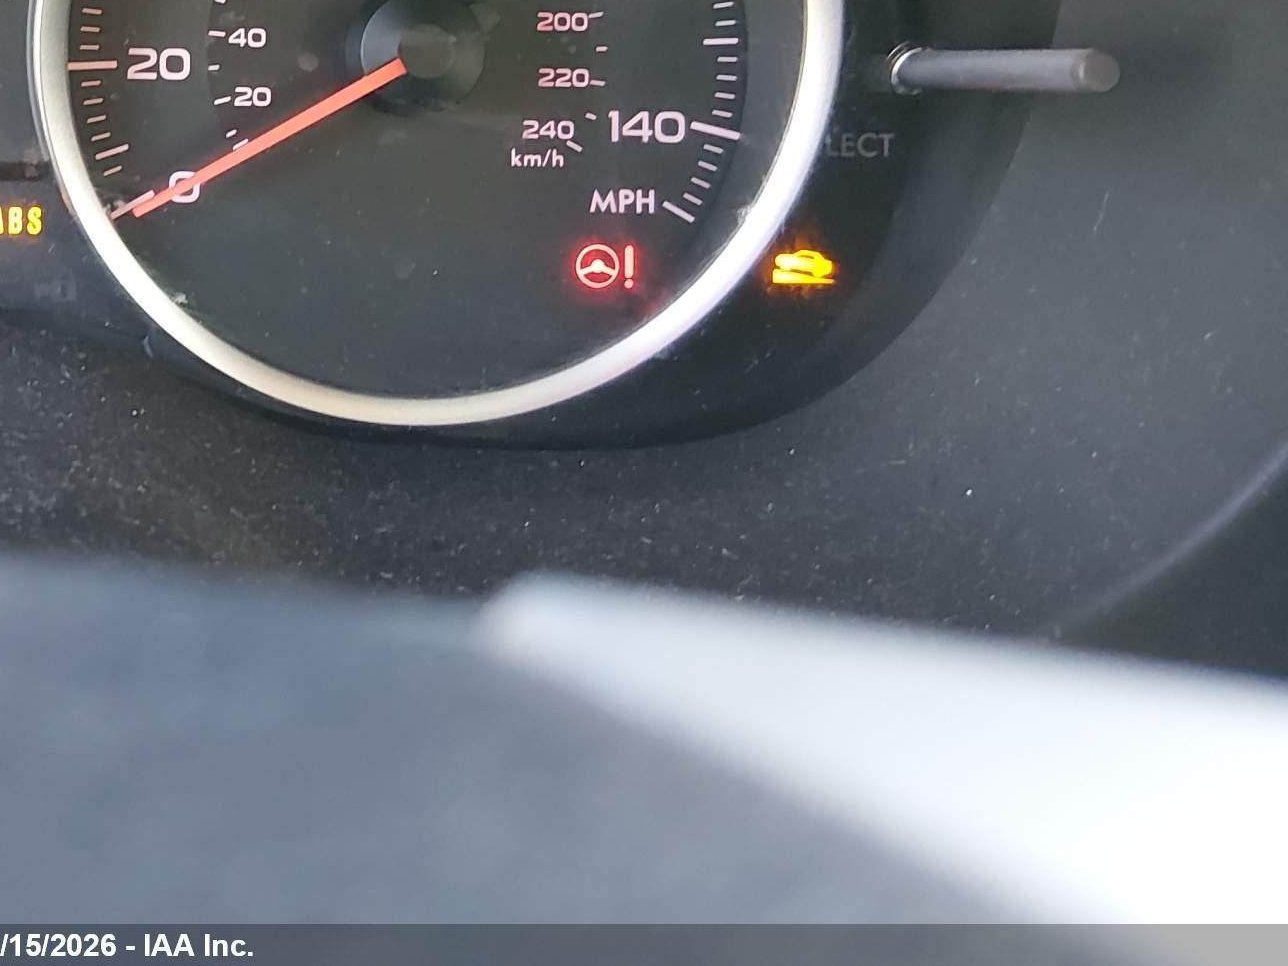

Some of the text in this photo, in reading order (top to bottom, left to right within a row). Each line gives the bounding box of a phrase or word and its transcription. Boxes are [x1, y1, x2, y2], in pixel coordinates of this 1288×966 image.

[536, 11, 589, 32] 200
[227, 27, 267, 48] 40
[126, 47, 192, 81] 20
[537, 68, 590, 88] 220
[233, 86, 272, 107] 20
[521, 120, 575, 140] 240
[607, 110, 687, 144] 140
[823, 131, 896, 159] LECT
[510, 147, 565, 168] km/h
[168, 170, 201, 204] 0
[589, 189, 655, 214] MPH
